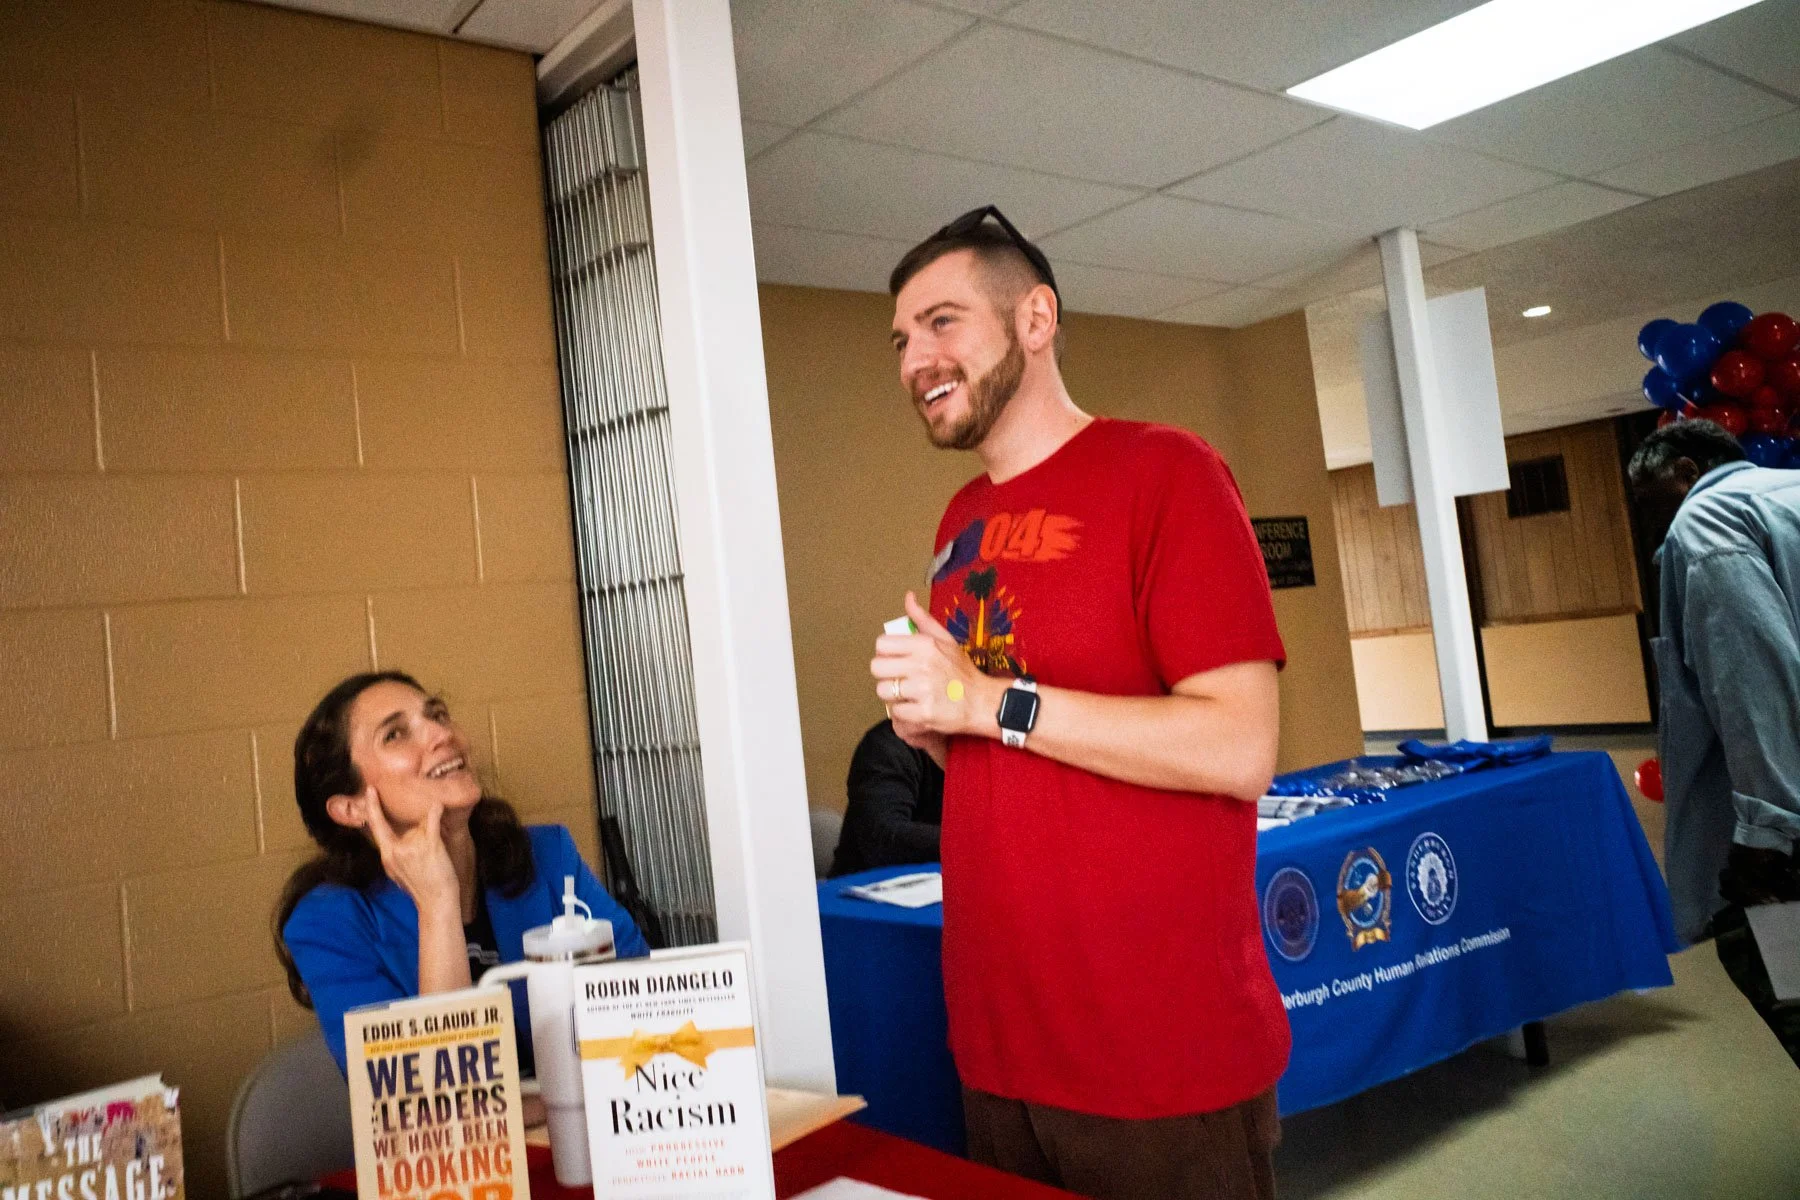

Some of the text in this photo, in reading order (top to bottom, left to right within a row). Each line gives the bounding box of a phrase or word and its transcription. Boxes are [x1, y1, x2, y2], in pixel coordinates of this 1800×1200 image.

[1254, 521, 1306, 540] NFERENCE
[585, 969, 734, 1001] ROBIN DIANGELO
[1332, 971, 1372, 998] County
[1374, 958, 1415, 984] Human
[363, 1018, 405, 1043] EDDIE
[424, 1009, 480, 1034] GLAUDE
[366, 1053, 424, 1100] WE
[434, 1039, 504, 1090] ARE
[635, 1062, 706, 1093] Nice
[381, 1084, 508, 1133] LEADERS
[610, 1094, 737, 1135] Racism
[64, 1134, 102, 1168] THE
[373, 1118, 509, 1160] WE HAVE BEEN
[376, 1141, 513, 1198] LOOKING
